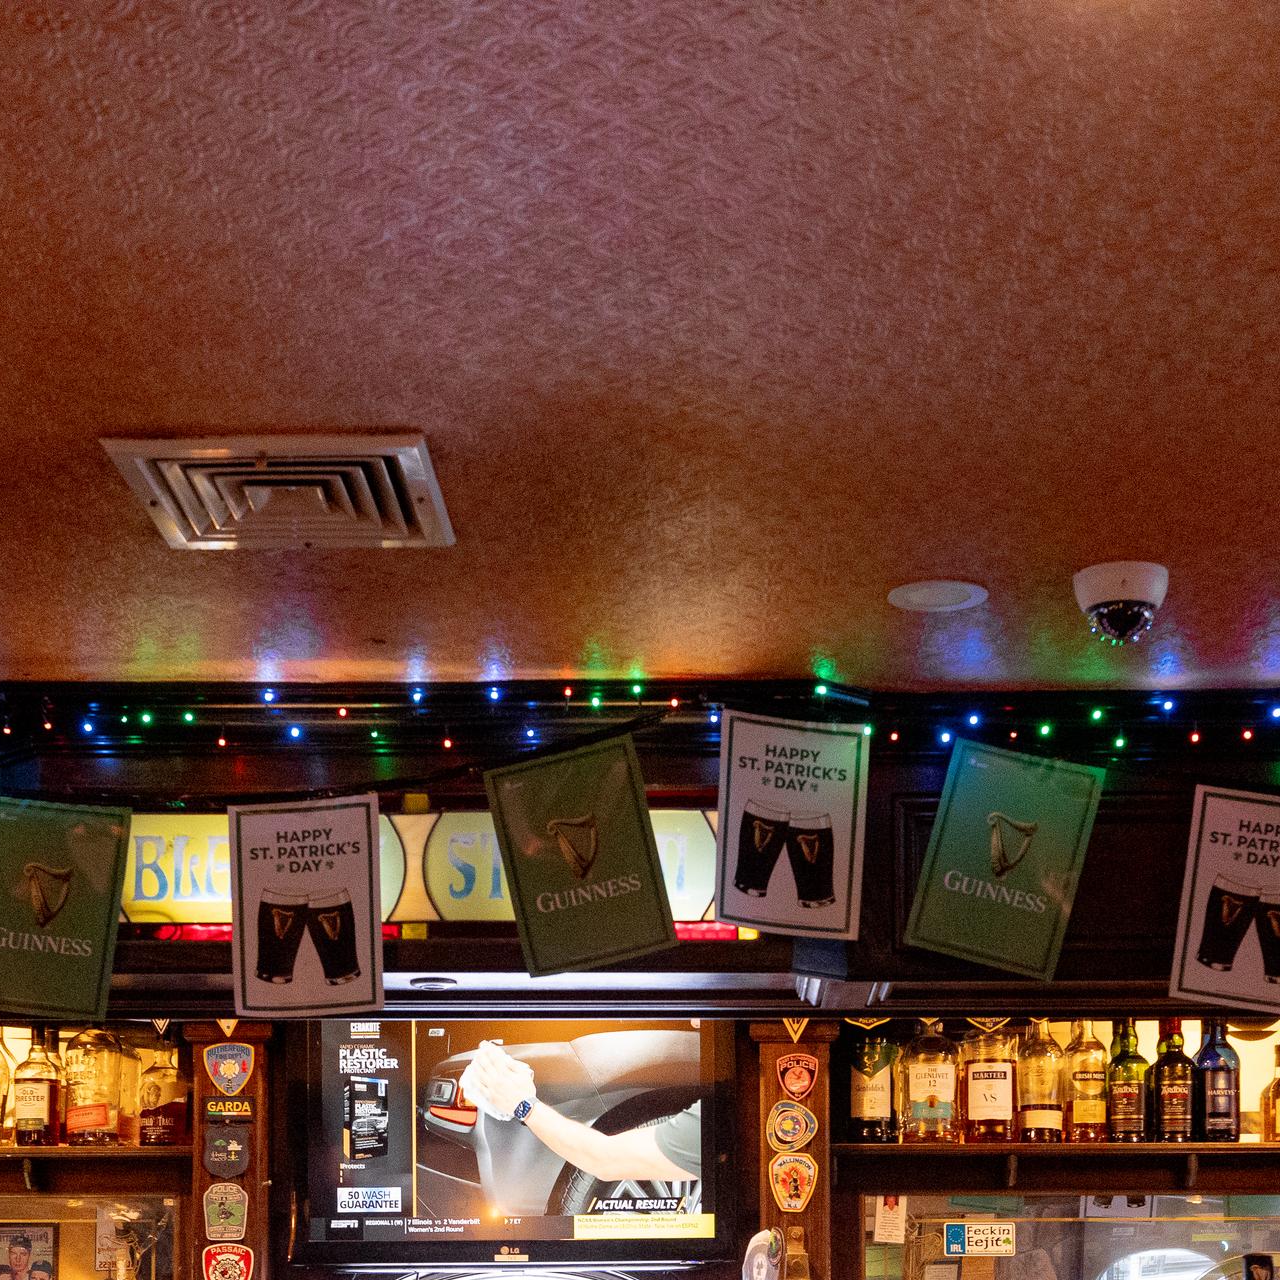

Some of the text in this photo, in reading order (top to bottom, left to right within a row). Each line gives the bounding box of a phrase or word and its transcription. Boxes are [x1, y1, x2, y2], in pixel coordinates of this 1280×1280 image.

[766, 745, 821, 763] HAPPY
[739, 756, 847, 782] ST. PATRICK'S
[775, 777, 806, 793] DAY
[277, 828, 332, 844] HAPPY
[1209, 831, 1233, 847] ST.
[250, 841, 360, 861] ST. PATRICK'S
[1246, 852, 1280, 868] DAY
[290, 859, 322, 874] DAY
[536, 873, 641, 913] GUINNESS
[944, 870, 1047, 912] GUINNESS
[339, 1048, 387, 1060] PLASTIC
[339, 1058, 399, 1070] RESTORER
[780, 1061, 816, 1070] POLICE
[915, 1073, 948, 1081] GLENLIVET
[928, 1080, 937, 1088] 12
[207, 1101, 251, 1112] GARDA
[777, 1158, 813, 1172] WALLINGTON
[212, 1186, 239, 1195] POLICE
[348, 1191, 391, 1200] 50 WASH
[340, 1200, 400, 1210] GUARANTEE
[595, 1199, 678, 1210] ACTUAL RESULTS
[330, 1219, 359, 1228] ESPN
[967, 1226, 1010, 1236] Feckin
[950, 1244, 963, 1253] IRL
[967, 1237, 1002, 1249] Eejit
[210, 1246, 247, 1256] PASSAIC
